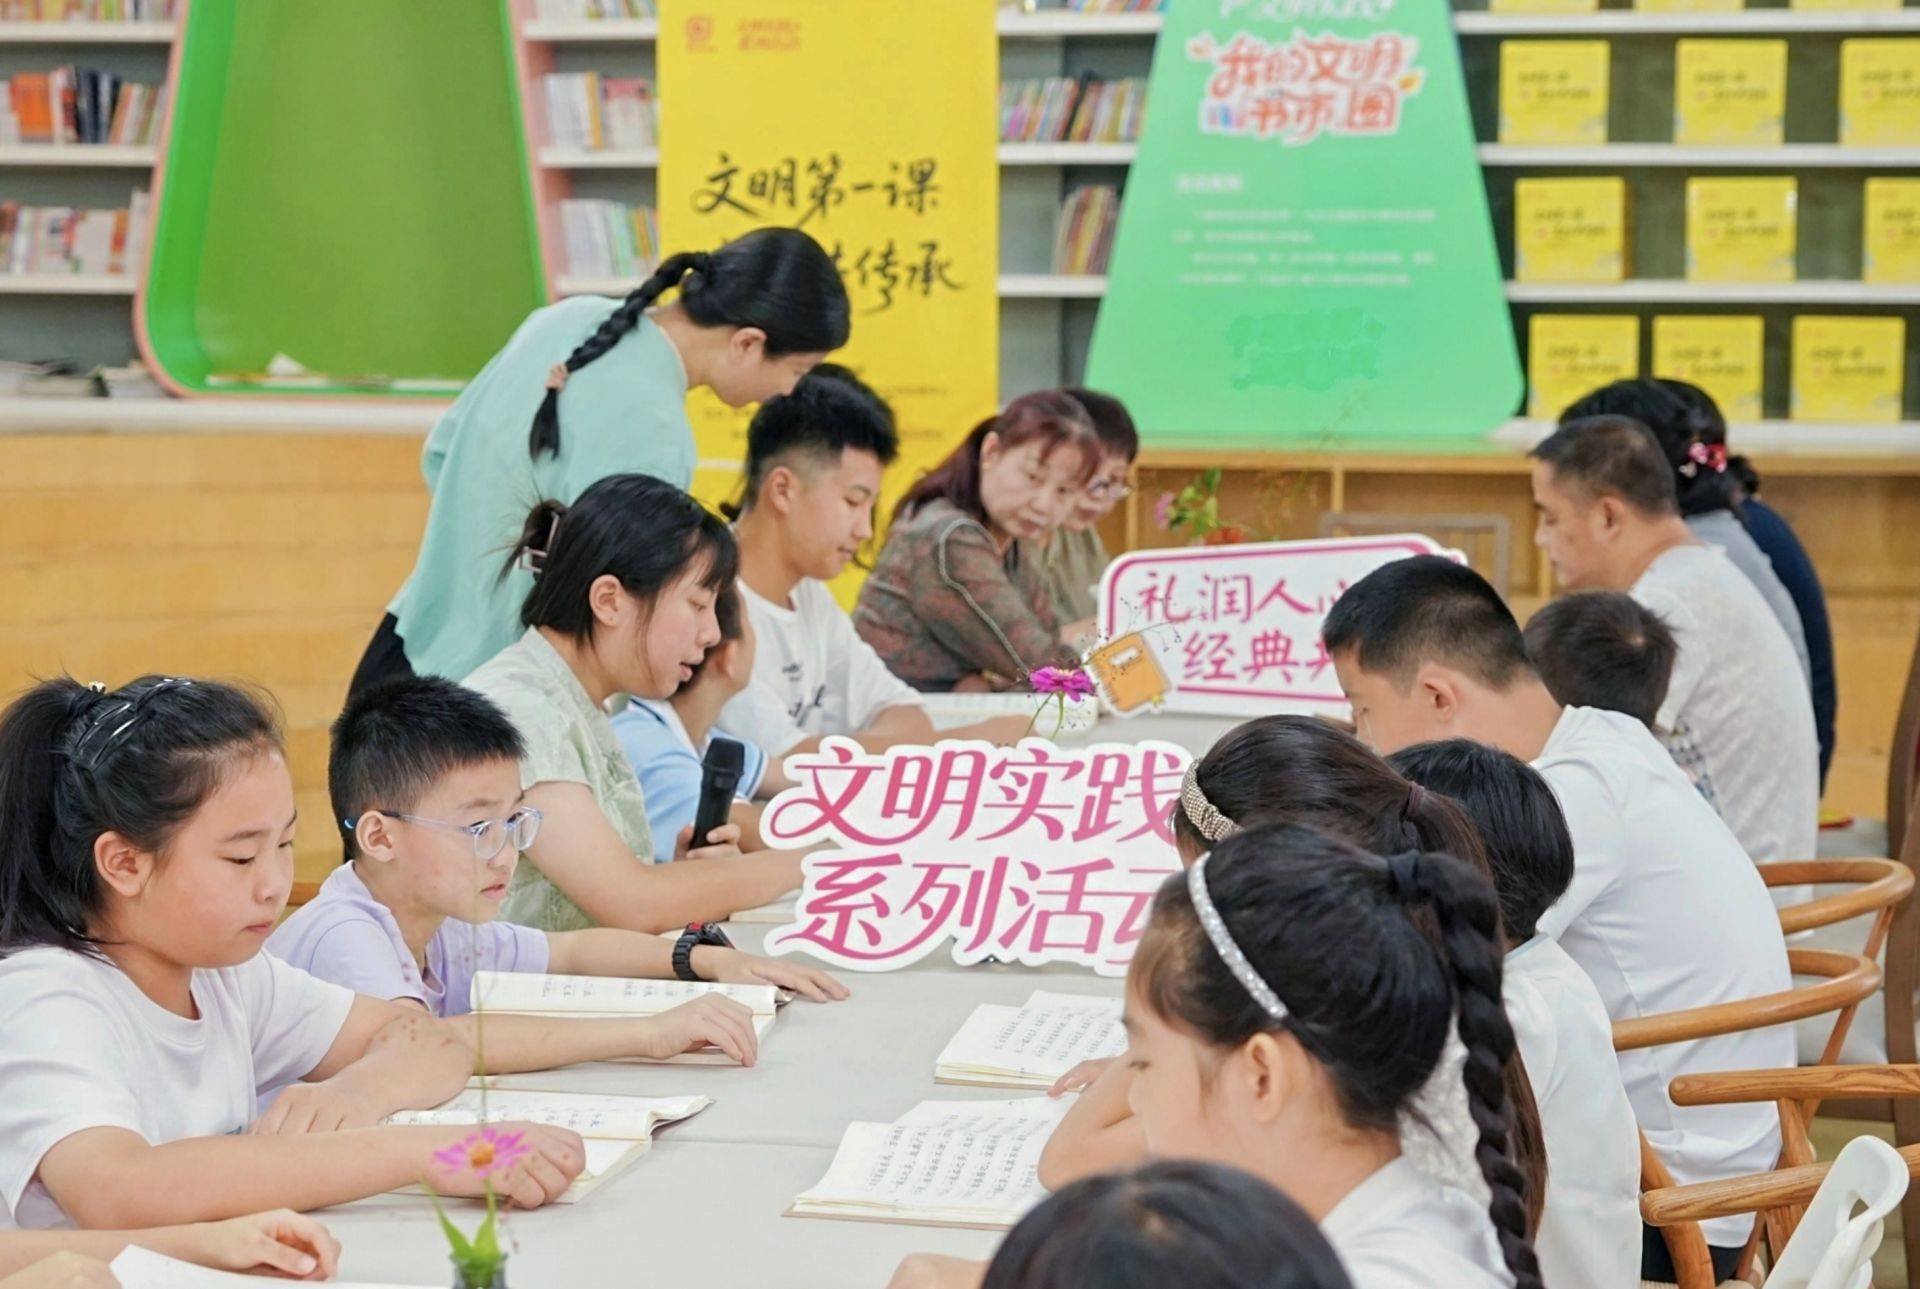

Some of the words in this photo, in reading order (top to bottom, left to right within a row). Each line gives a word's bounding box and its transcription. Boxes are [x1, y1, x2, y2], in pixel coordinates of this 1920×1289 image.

[691, 152, 939, 229] 文明第一课
[770, 745, 1183, 846] 文明实践
